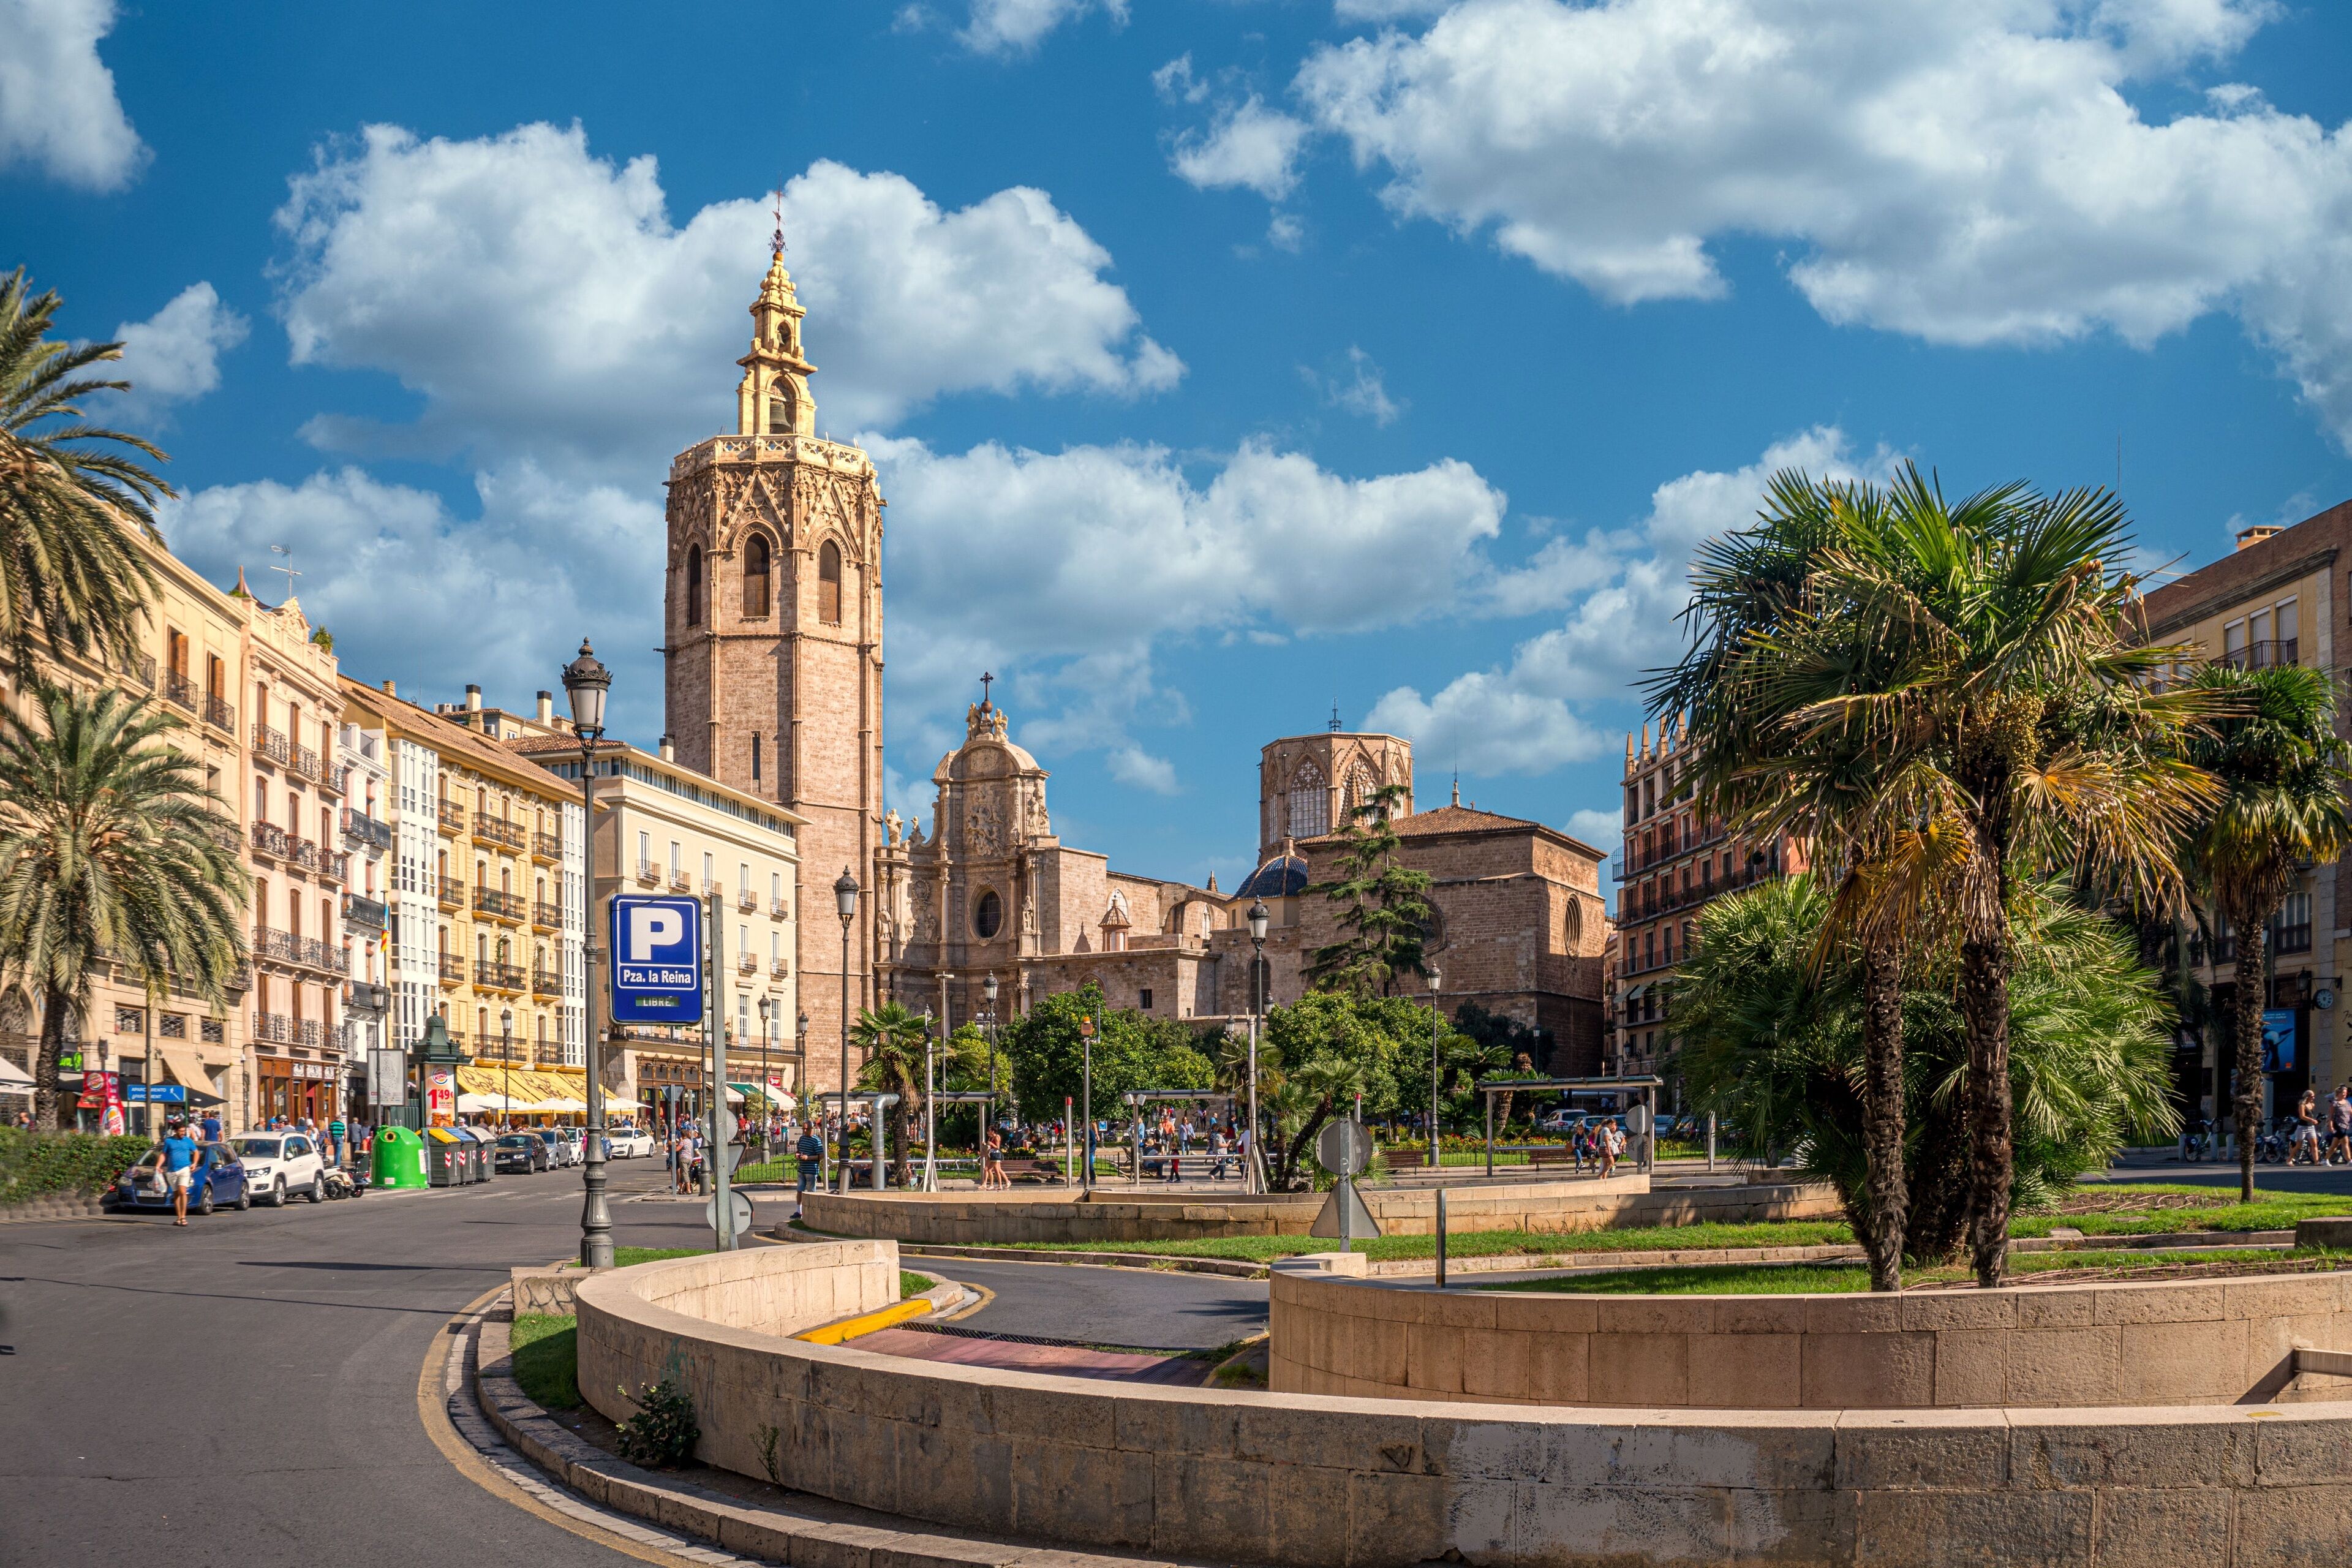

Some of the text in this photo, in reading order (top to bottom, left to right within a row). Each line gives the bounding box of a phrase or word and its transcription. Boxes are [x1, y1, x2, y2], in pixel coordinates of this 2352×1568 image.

[631, 907, 683, 960] P
[624, 969, 691, 984] Pza. la Reina
[643, 996, 672, 1006] LIBRE
